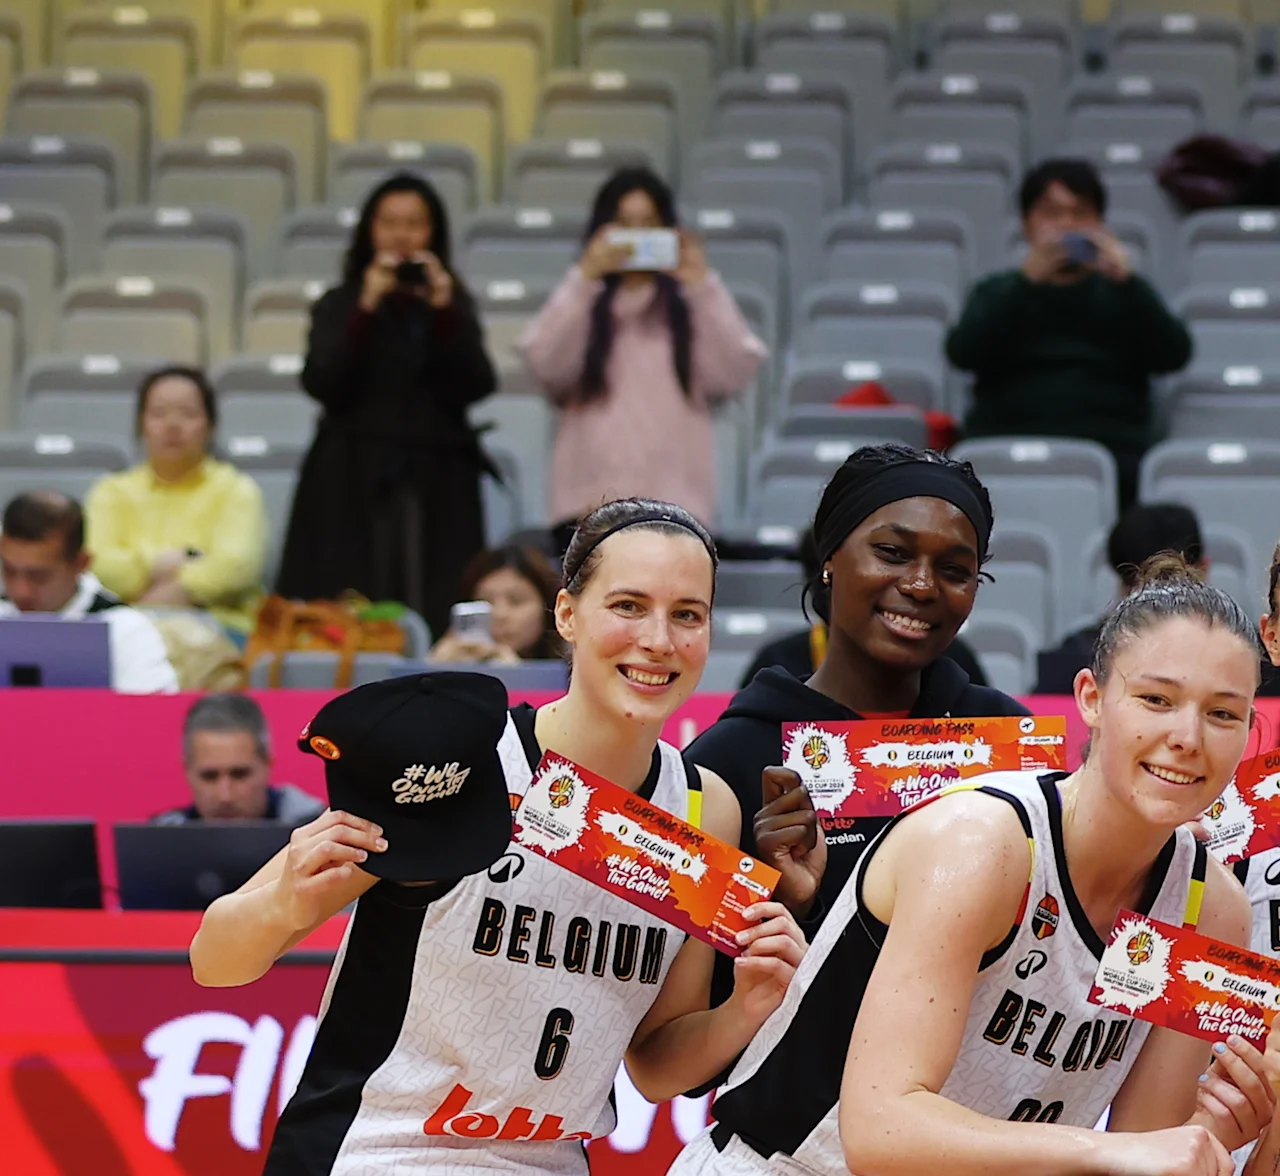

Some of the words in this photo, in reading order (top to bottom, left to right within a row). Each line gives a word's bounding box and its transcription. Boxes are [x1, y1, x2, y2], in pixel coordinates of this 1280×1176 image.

[881, 722, 942, 737] BOARDING
[945, 722, 976, 736] PASS
[906, 749, 954, 761] BELGIUM
[633, 833, 676, 861] BELGIUM
[824, 831, 866, 847] crelan
[471, 896, 669, 985] BELGIUM
[1221, 976, 1269, 1000] BELGIUM
[534, 1006, 576, 1081] 6
